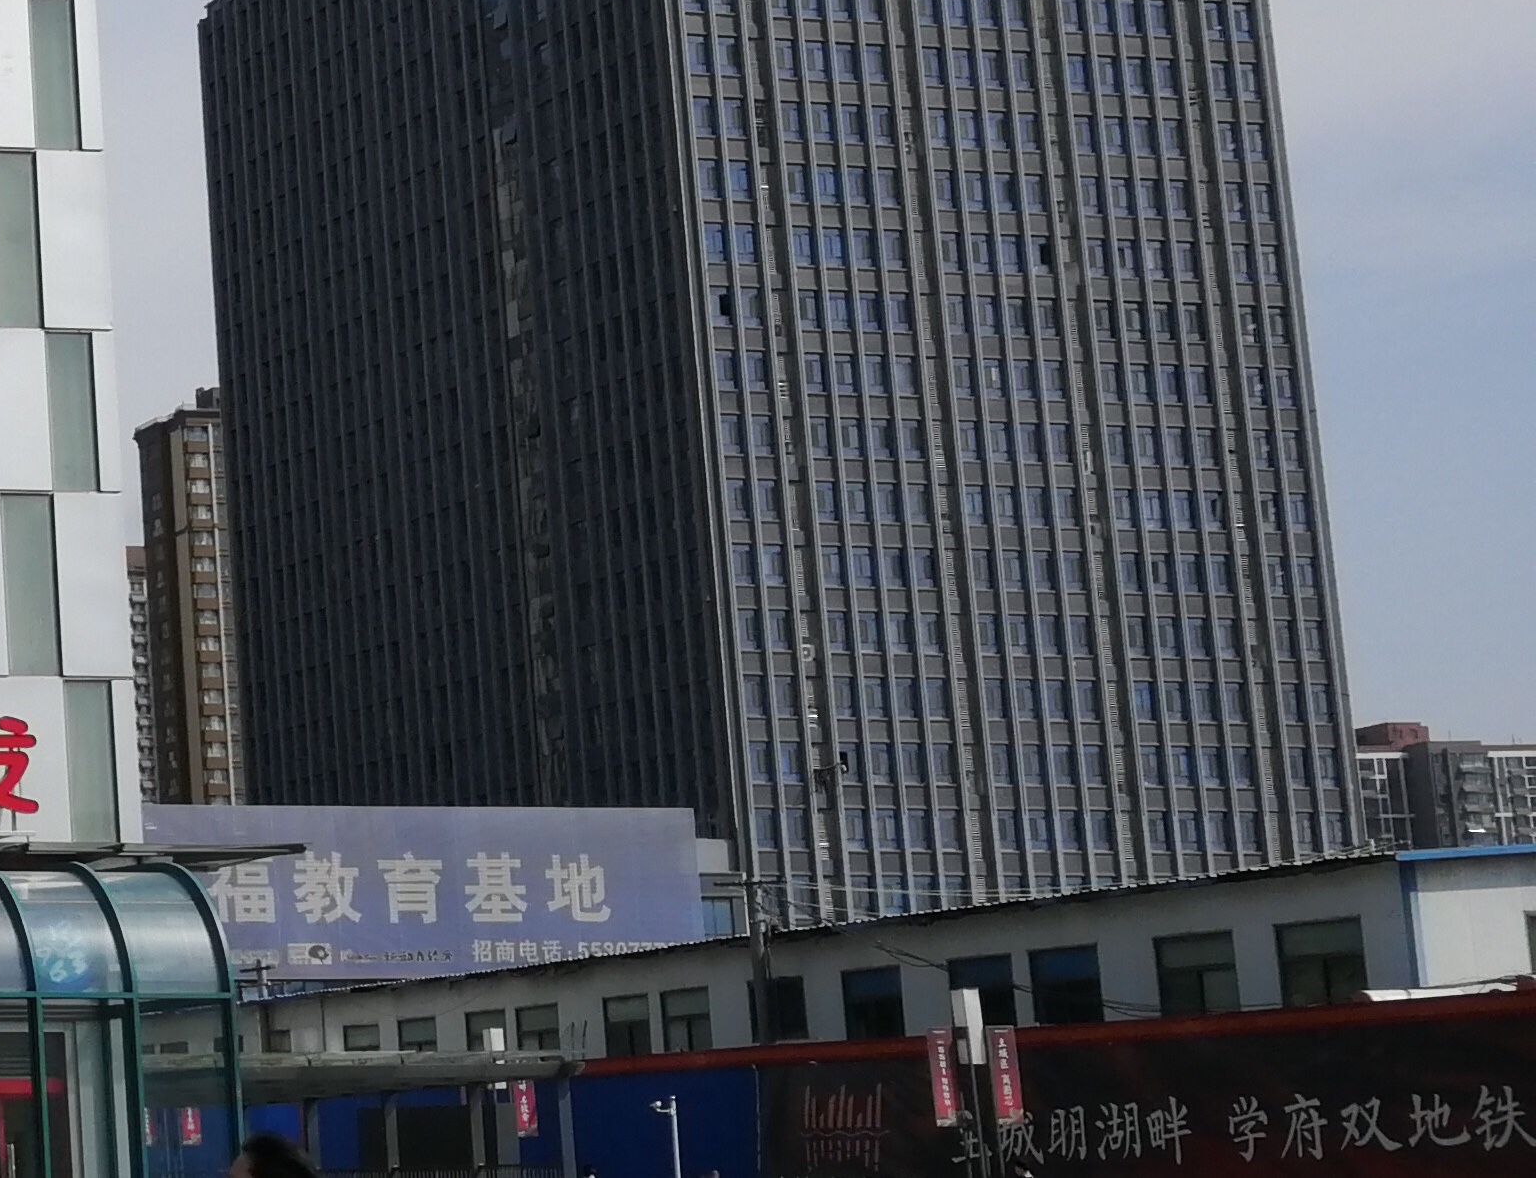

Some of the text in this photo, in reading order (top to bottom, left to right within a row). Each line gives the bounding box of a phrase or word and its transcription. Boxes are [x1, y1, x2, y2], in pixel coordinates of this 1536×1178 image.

[1228, 1084, 1536, 1163] 学府双地铁
